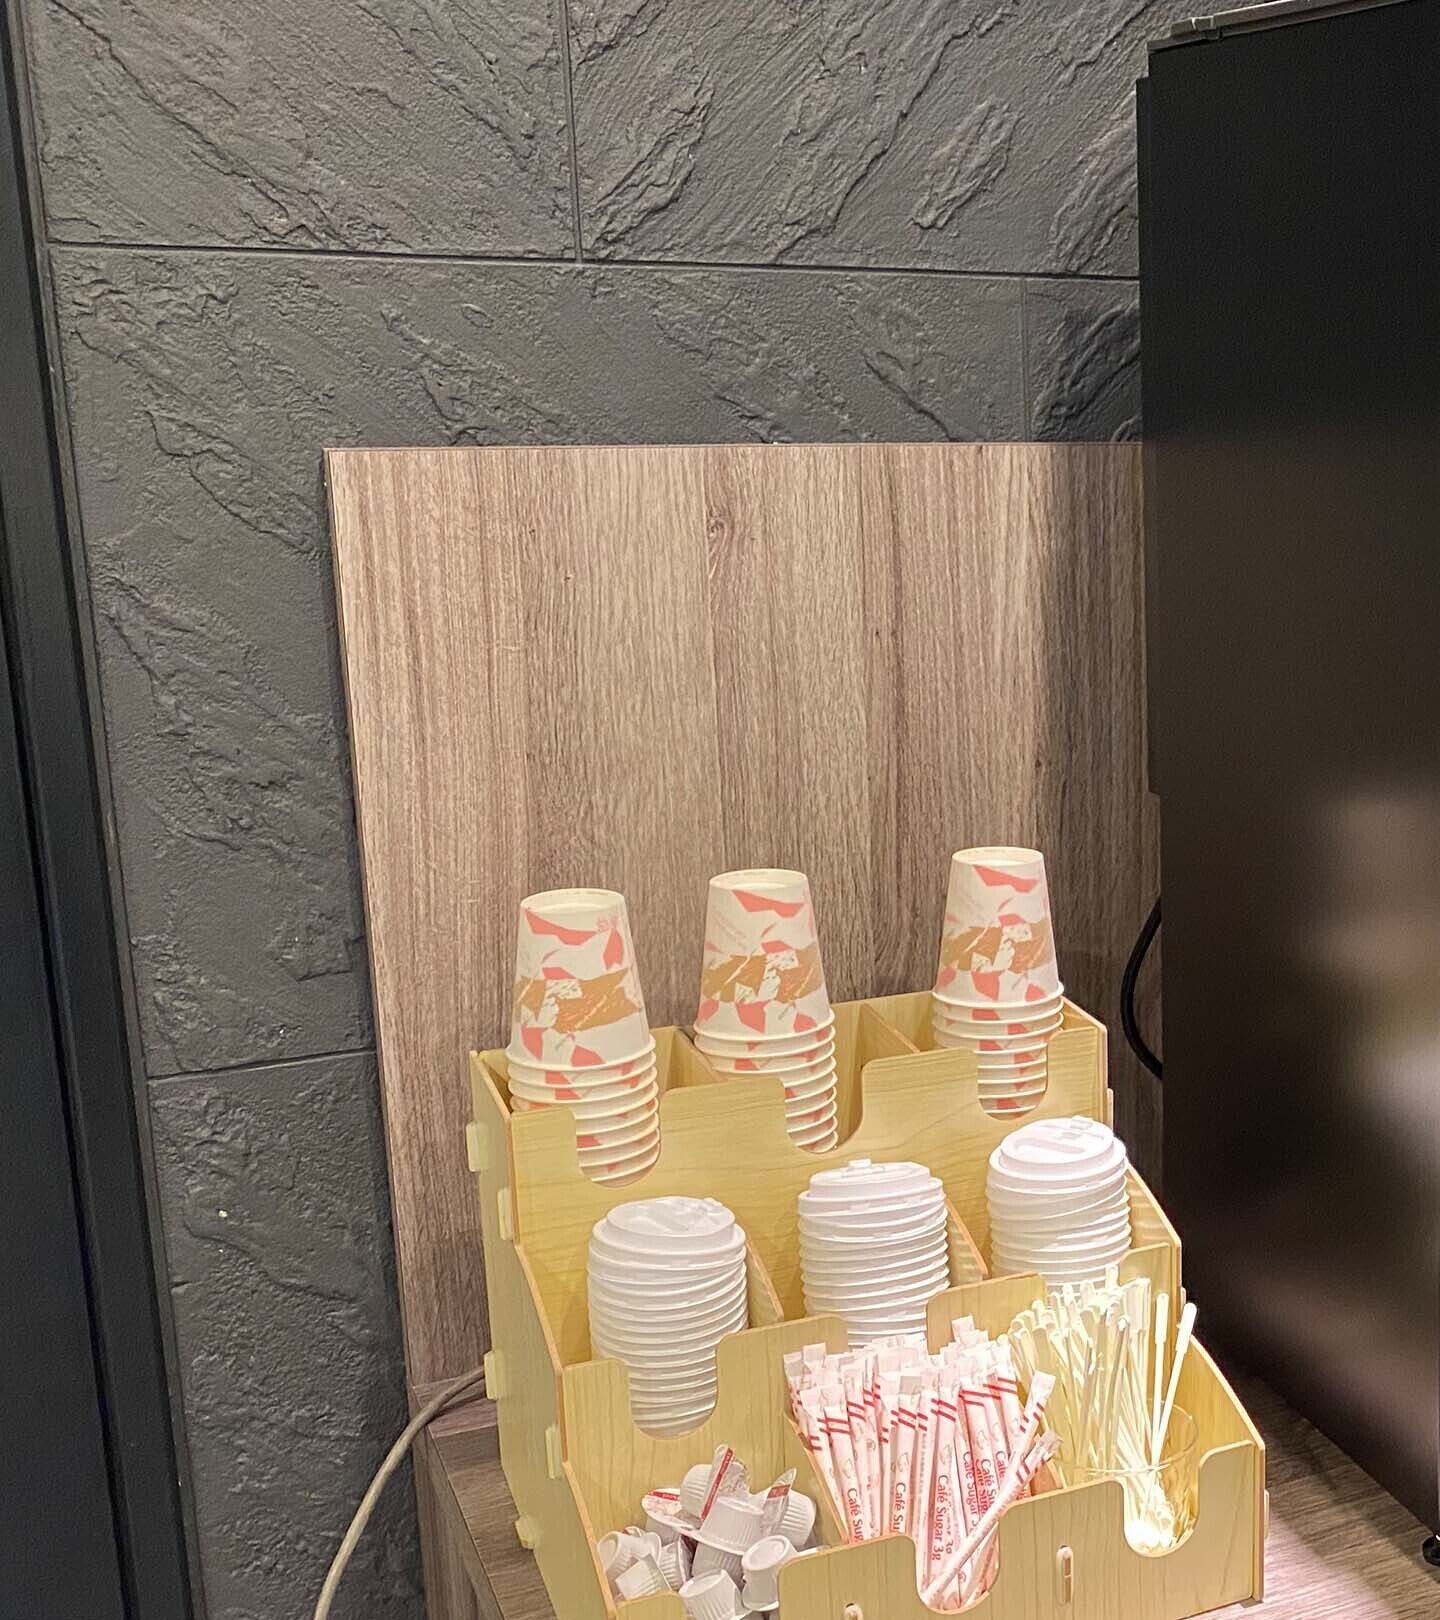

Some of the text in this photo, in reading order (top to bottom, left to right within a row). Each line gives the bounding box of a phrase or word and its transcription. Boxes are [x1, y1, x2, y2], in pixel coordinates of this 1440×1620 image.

[846, 1487, 861, 1517] Café
[895, 1481, 907, 1512] Café
[931, 1474, 949, 1561] Café Sugar 3g
